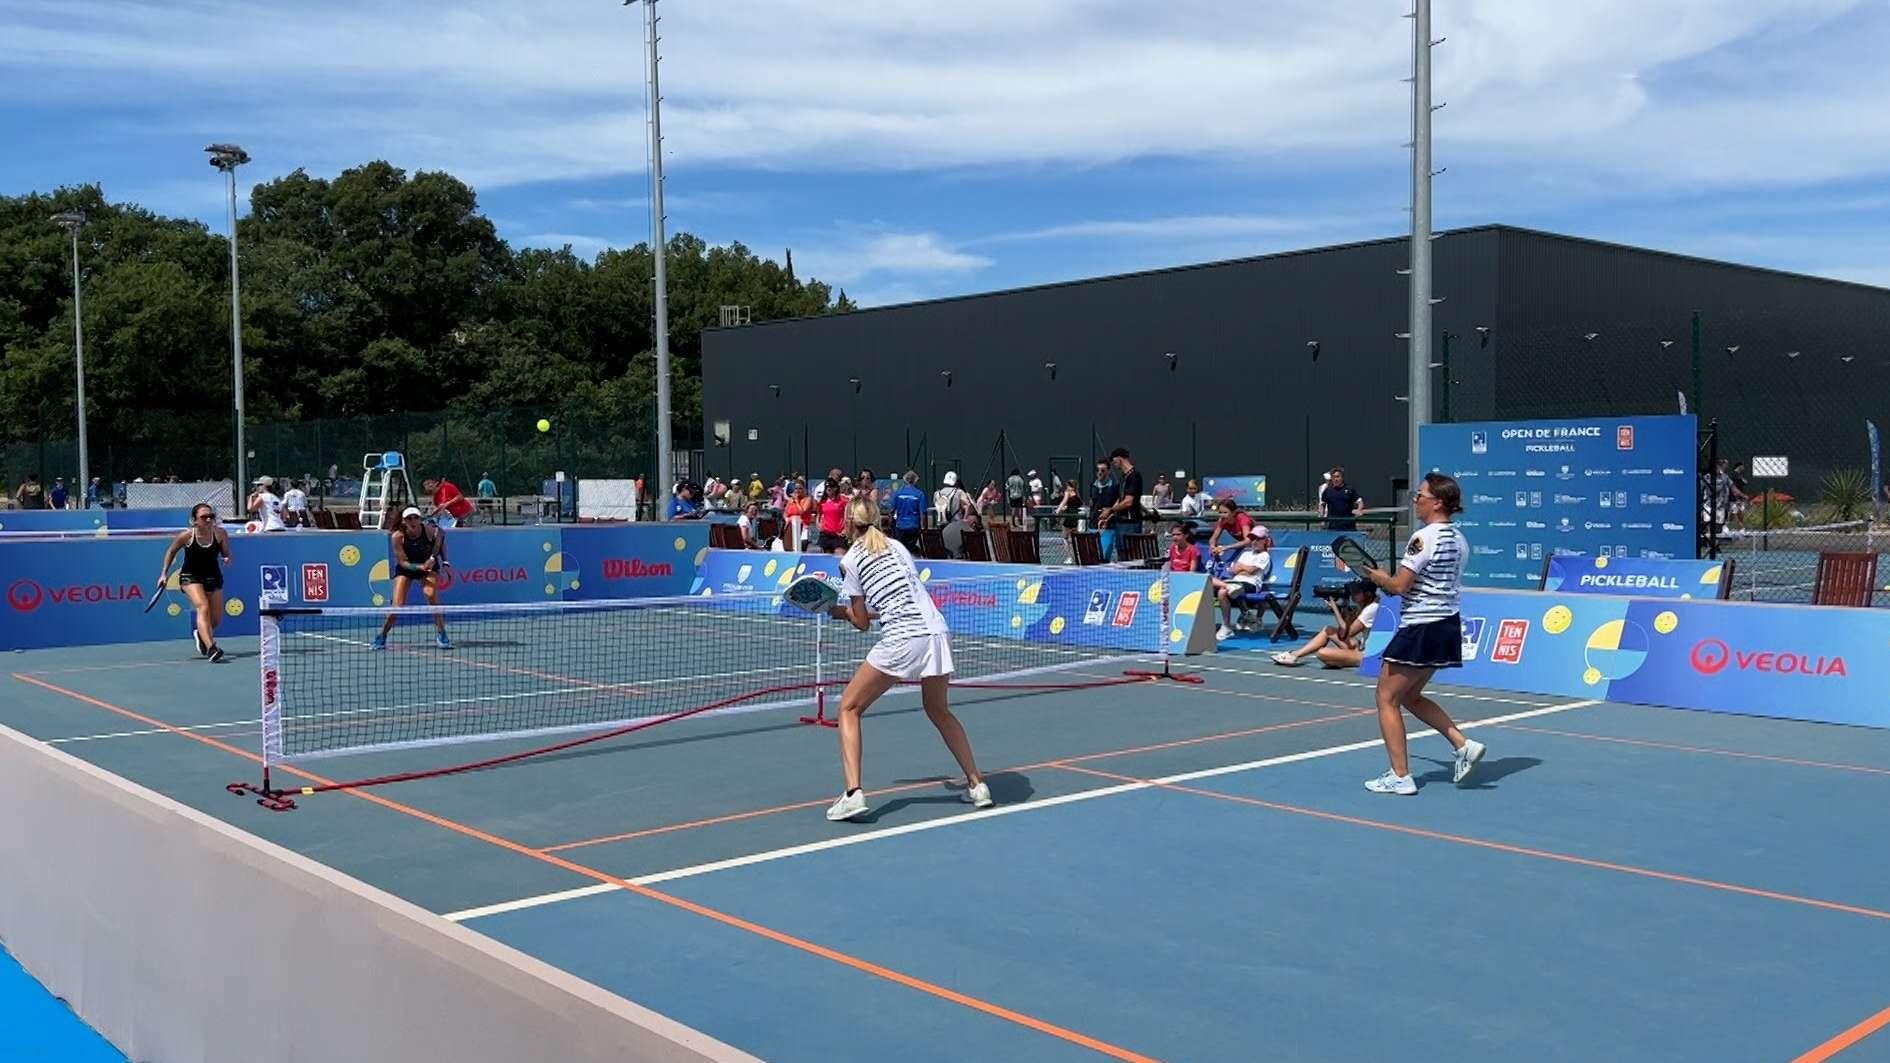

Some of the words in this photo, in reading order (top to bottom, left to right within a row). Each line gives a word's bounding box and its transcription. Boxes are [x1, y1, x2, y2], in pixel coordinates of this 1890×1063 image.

[1502, 429, 1533, 439] OPEN
[1535, 428, 1551, 438] DE
[1553, 427, 1600, 438] FRANCE
[1525, 444, 1576, 453] PICKLEBALL
[306, 568, 324, 581] TEN
[459, 566, 528, 584] VEOLIA
[602, 558, 672, 579] Wilson
[1580, 574, 1680, 589] PICKLEBALL
[49, 584, 144, 604] VEOLIA
[307, 585, 324, 597] NIS
[1502, 625, 1523, 639] TEN
[1496, 644, 1519, 657] NIS
[1735, 650, 1848, 677] VEOLIA
